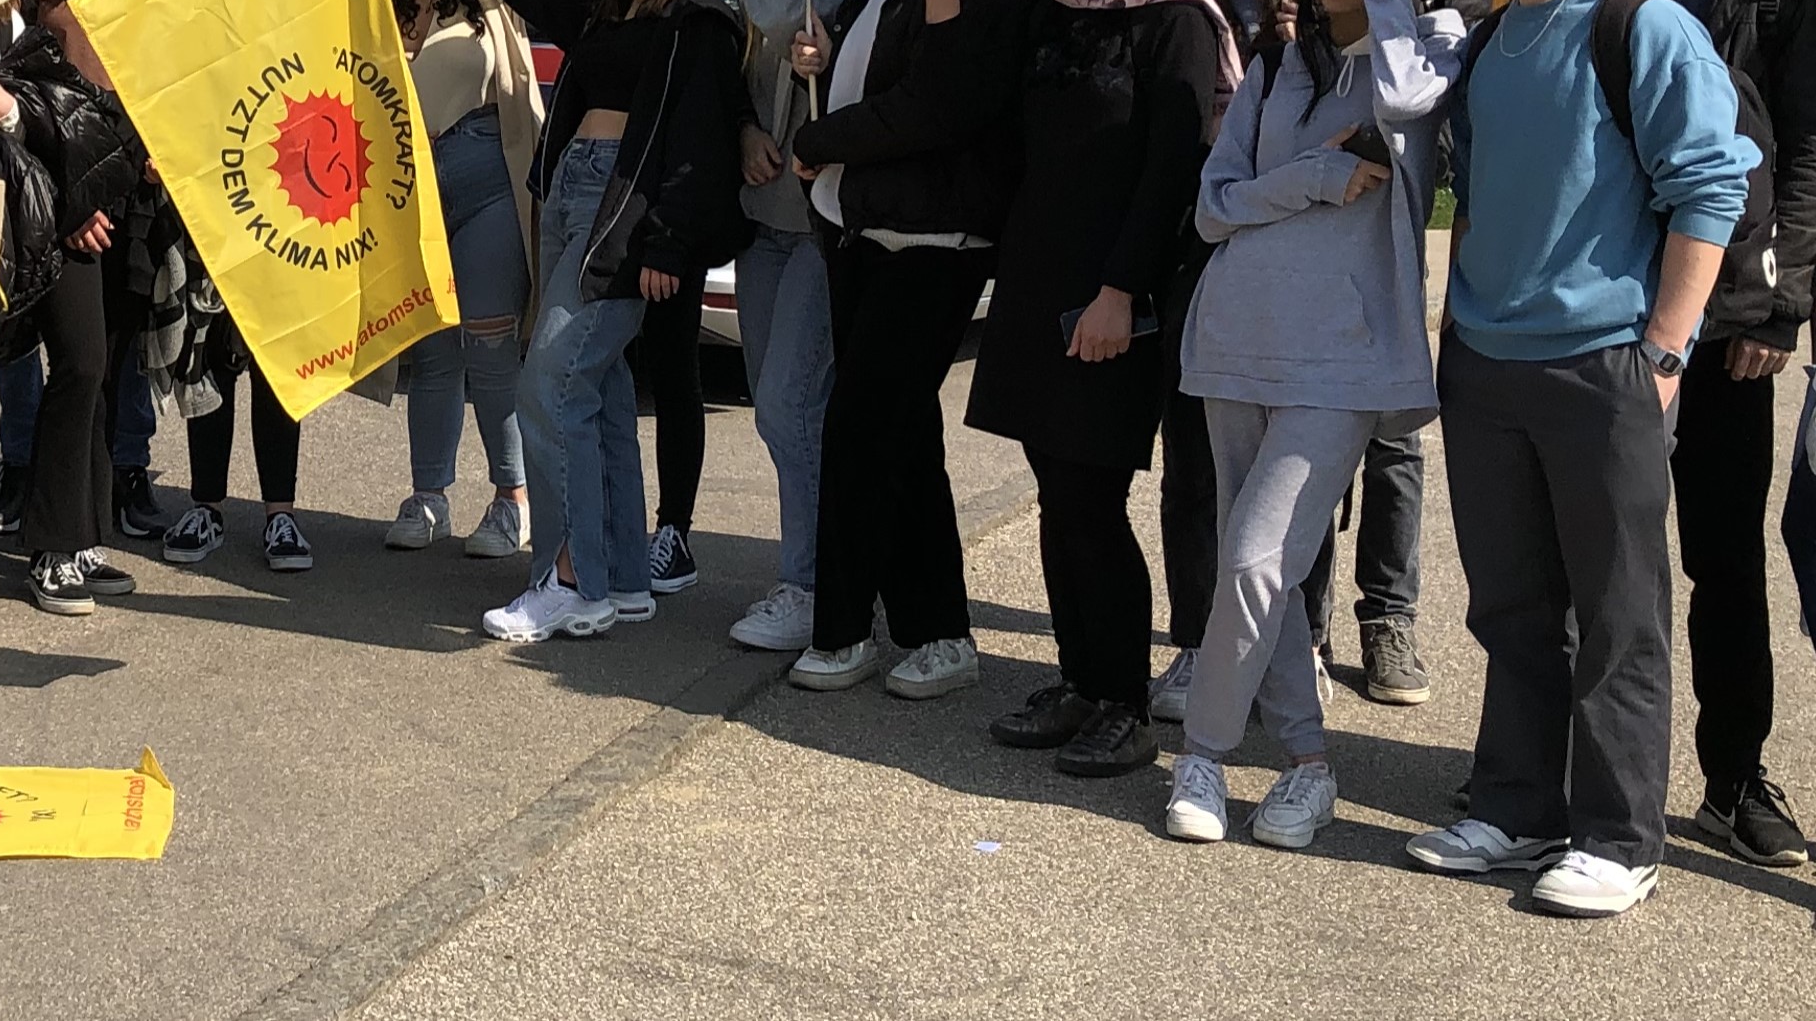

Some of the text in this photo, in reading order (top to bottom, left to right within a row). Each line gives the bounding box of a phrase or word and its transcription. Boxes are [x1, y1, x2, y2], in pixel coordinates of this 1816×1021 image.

[221, 51, 379, 272] NUTZT DEM KLIMA NIX!
[335, 47, 417, 210] ATOMKRAFT?
